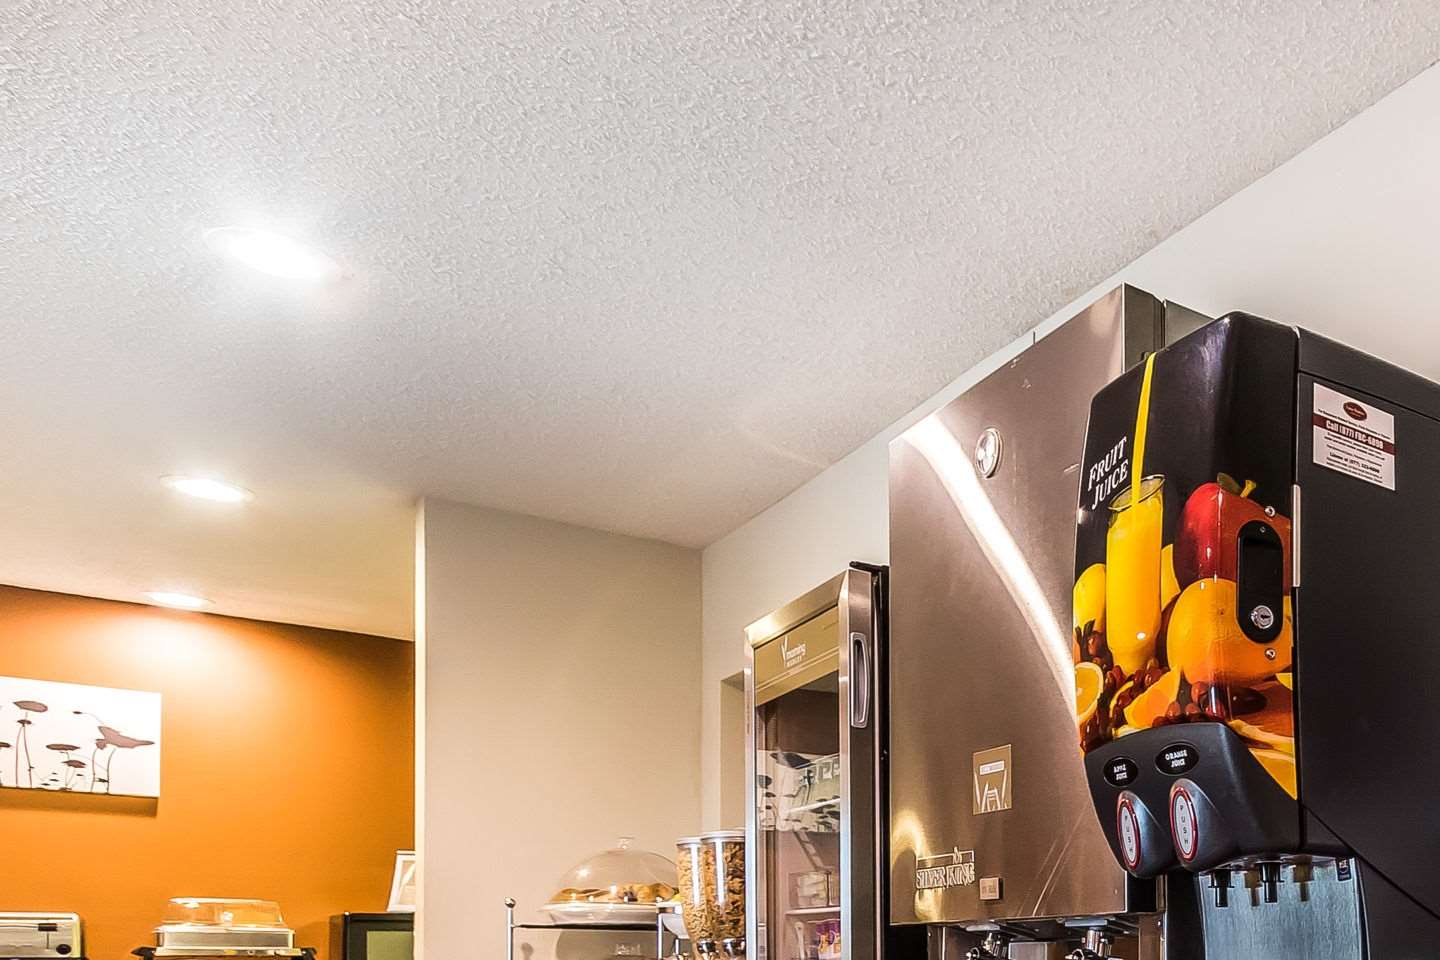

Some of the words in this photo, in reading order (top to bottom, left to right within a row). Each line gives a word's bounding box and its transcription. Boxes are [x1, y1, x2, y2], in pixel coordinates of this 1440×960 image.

[1088, 436, 1127, 492] FRUIT
[1092, 459, 1129, 510] JUICE
[946, 862, 976, 889] KING
